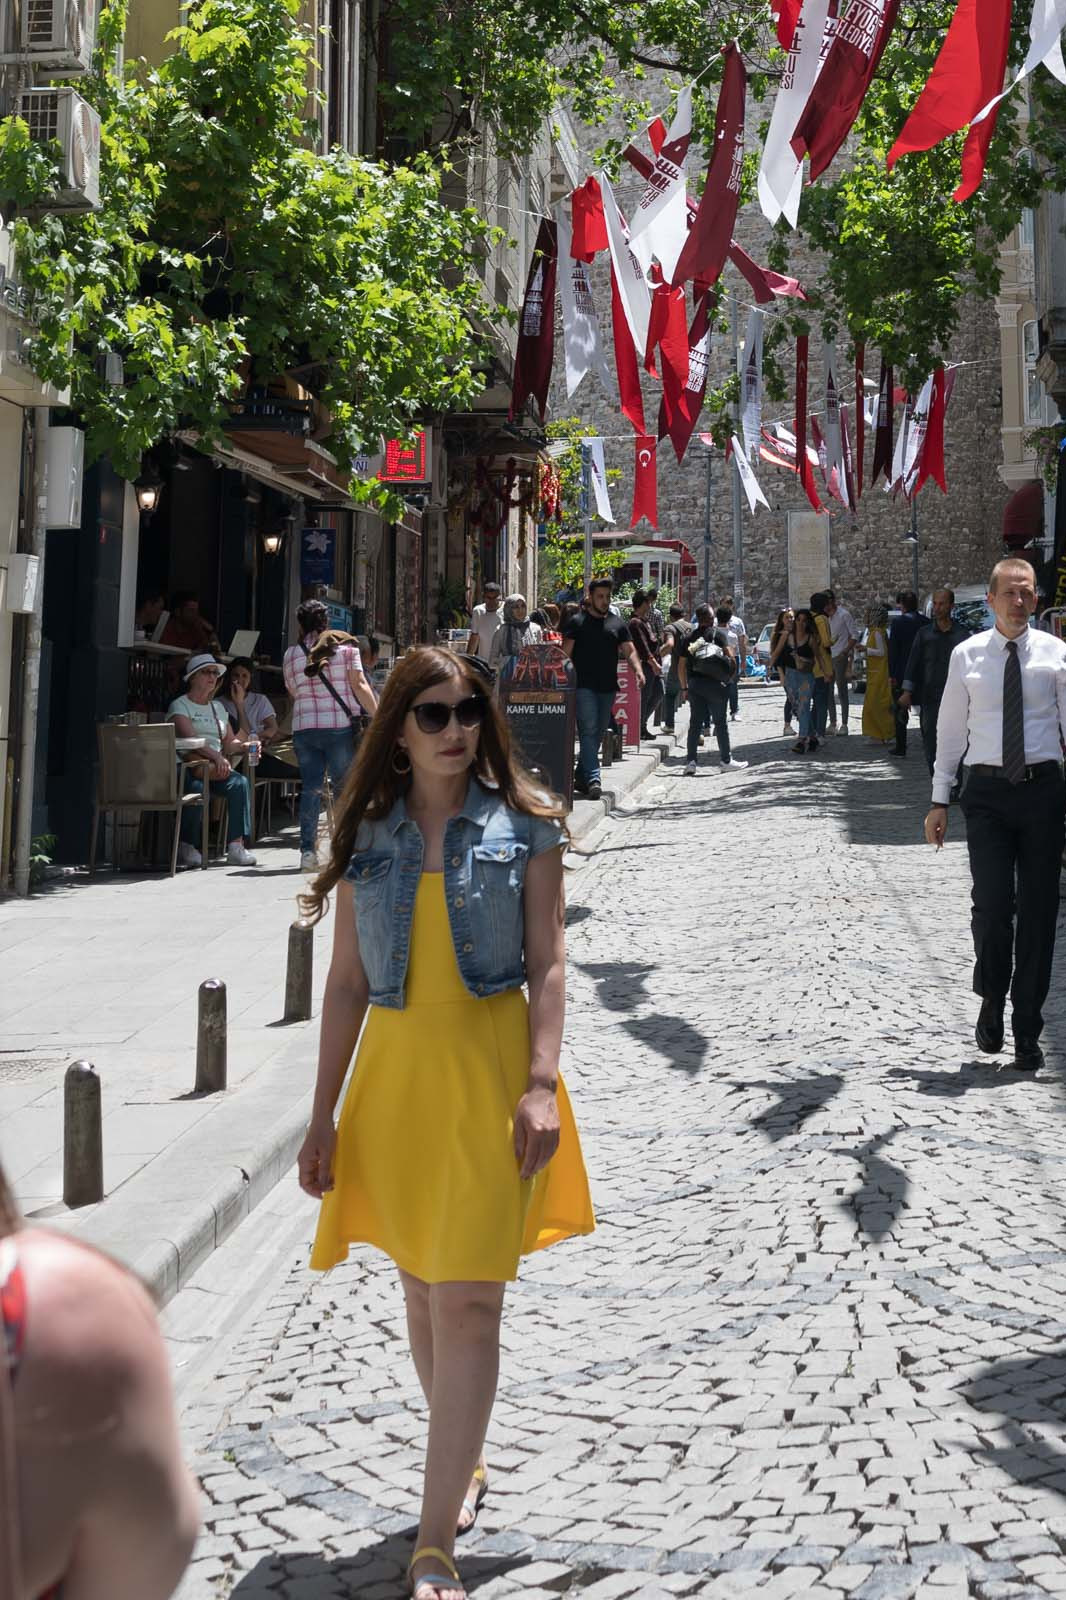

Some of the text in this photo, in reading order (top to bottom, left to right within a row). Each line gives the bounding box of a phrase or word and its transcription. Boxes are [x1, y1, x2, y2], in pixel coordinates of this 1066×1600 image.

[506, 703, 566, 715] KAHVE LİMANI
[614, 662, 629, 746] ECZA
